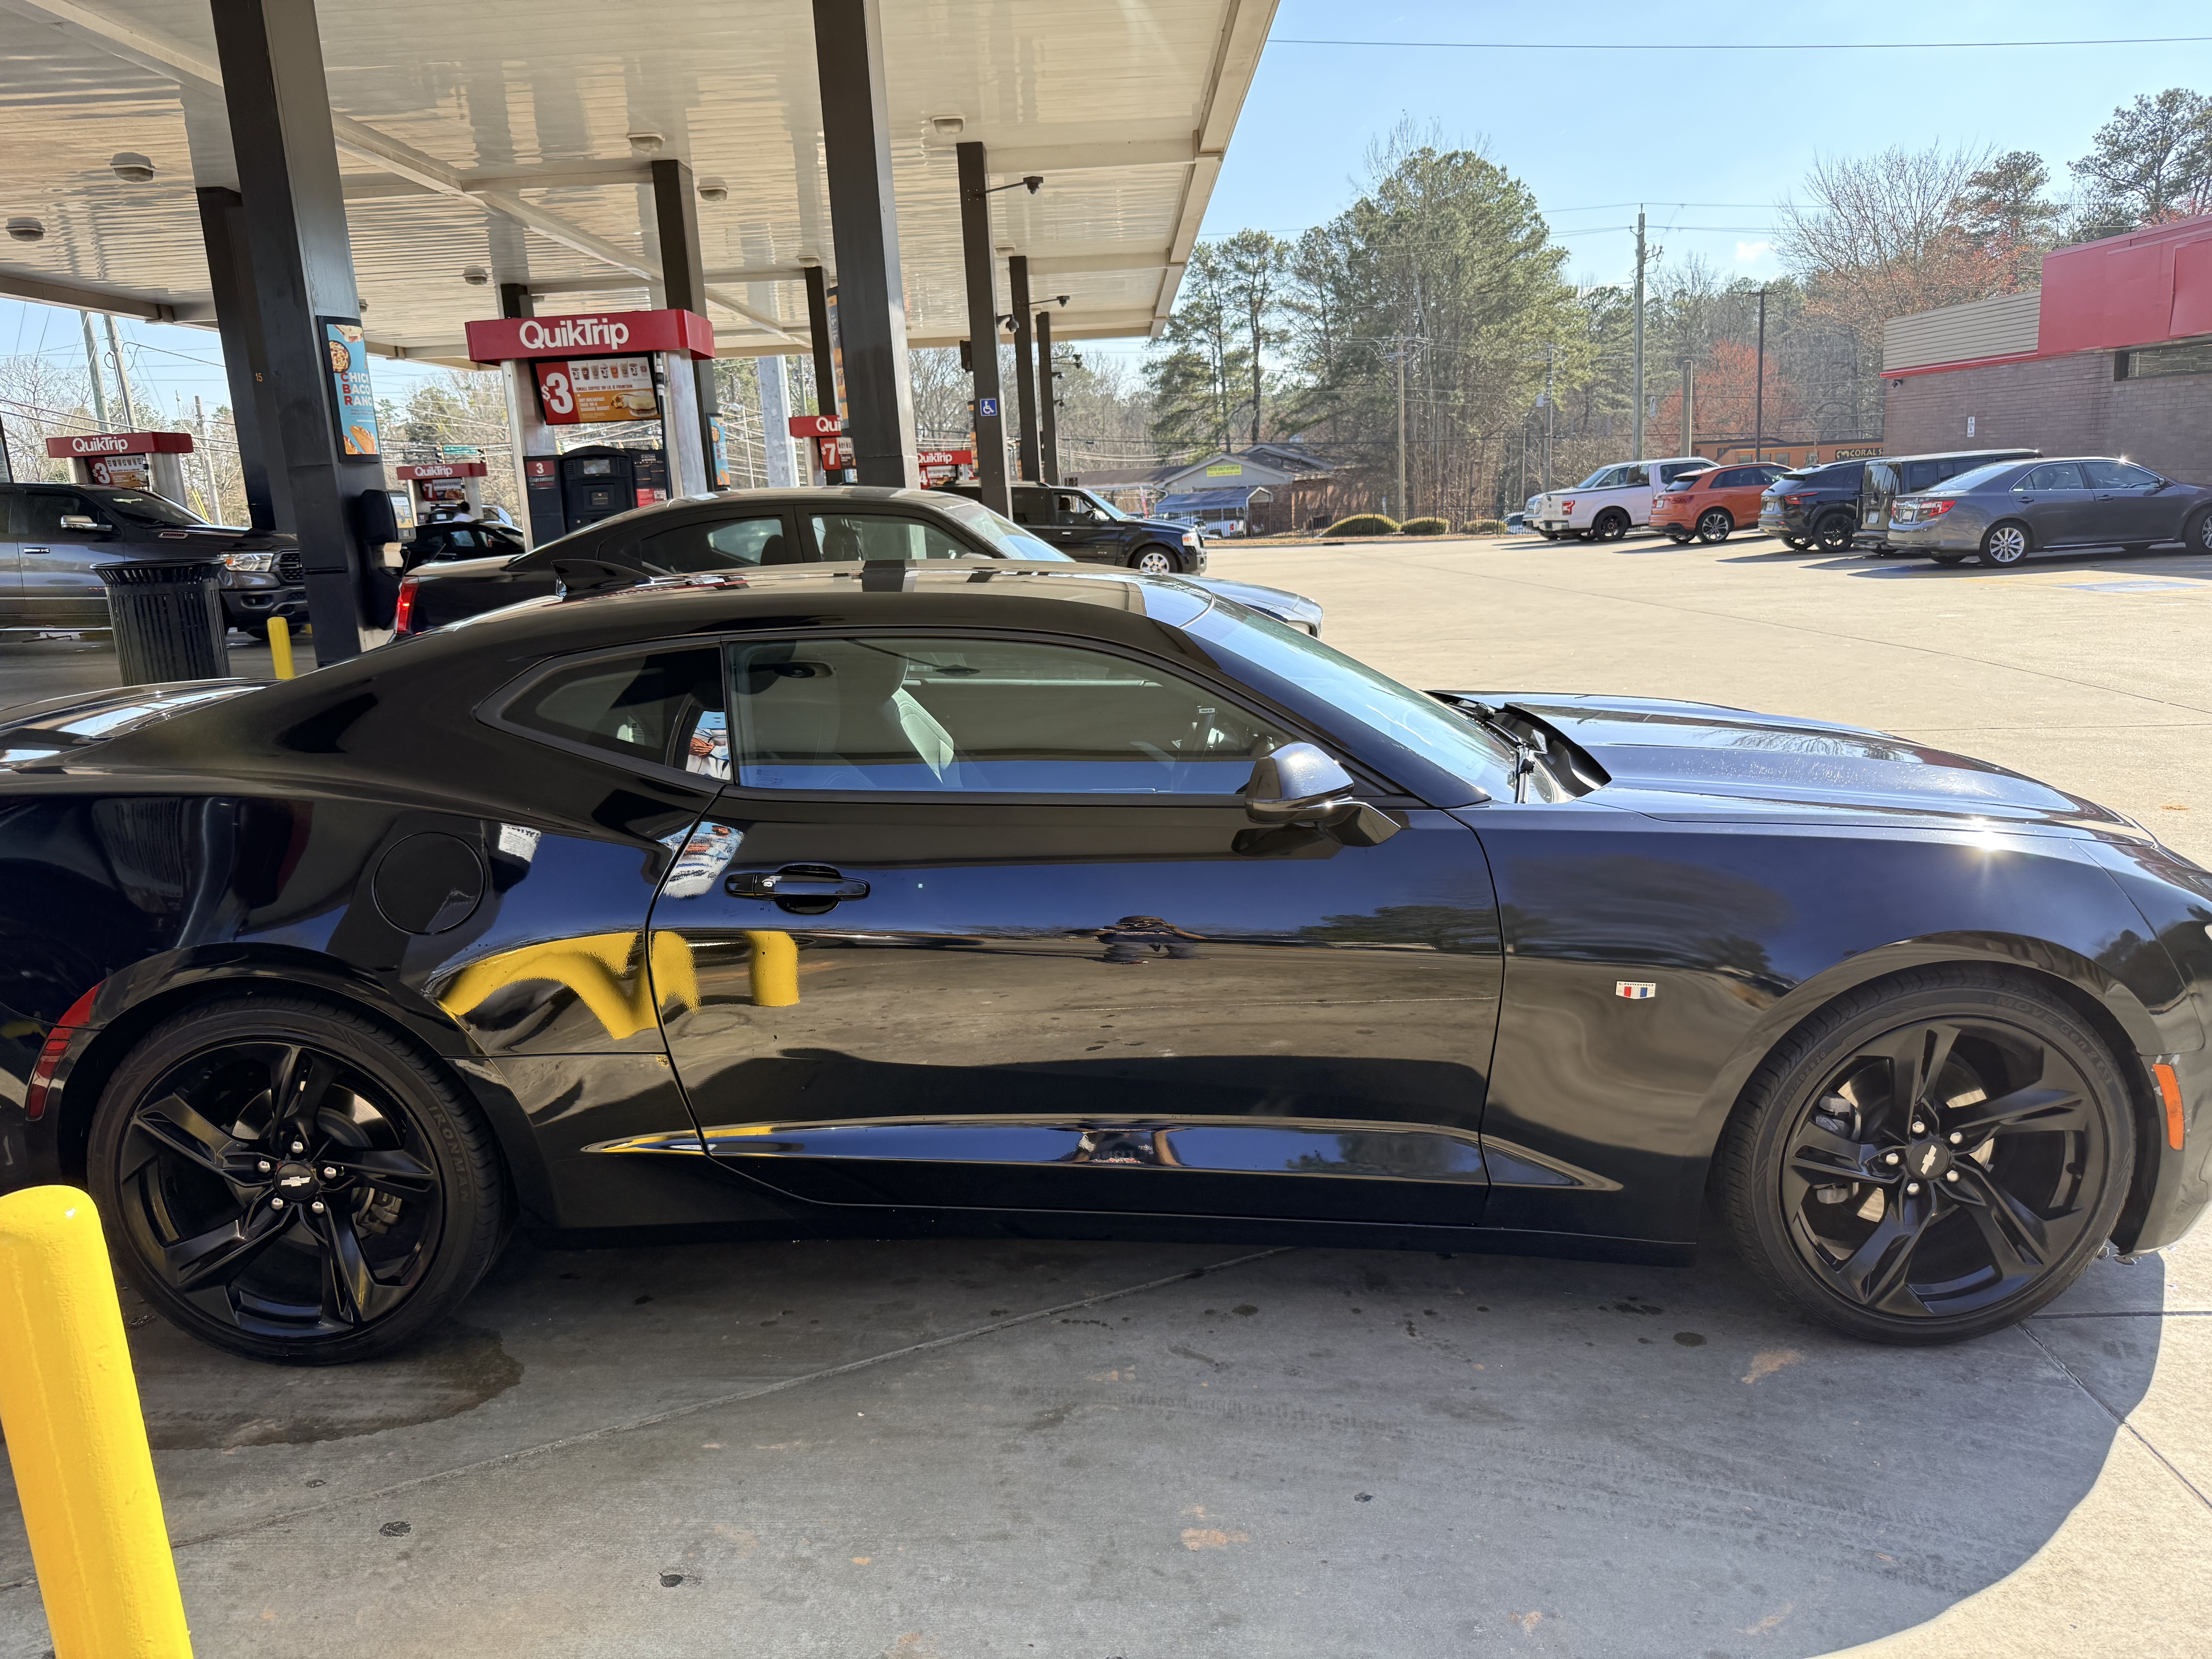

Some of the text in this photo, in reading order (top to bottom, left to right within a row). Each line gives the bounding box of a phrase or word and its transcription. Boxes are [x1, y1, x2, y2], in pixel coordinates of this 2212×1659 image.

[519, 318, 629, 350] QuikTrip
[256, 373, 263, 382] 15
[541, 372, 574, 414] $3
[72, 436, 128, 452] QuikTrip
[917, 452, 953, 464] QuikTrip
[1850, 448, 1877, 457] CORAL
[414, 465, 453, 477] QuikTrip
[536, 463, 544, 474] 3
[427, 1106, 470, 1202] IRONMAN
